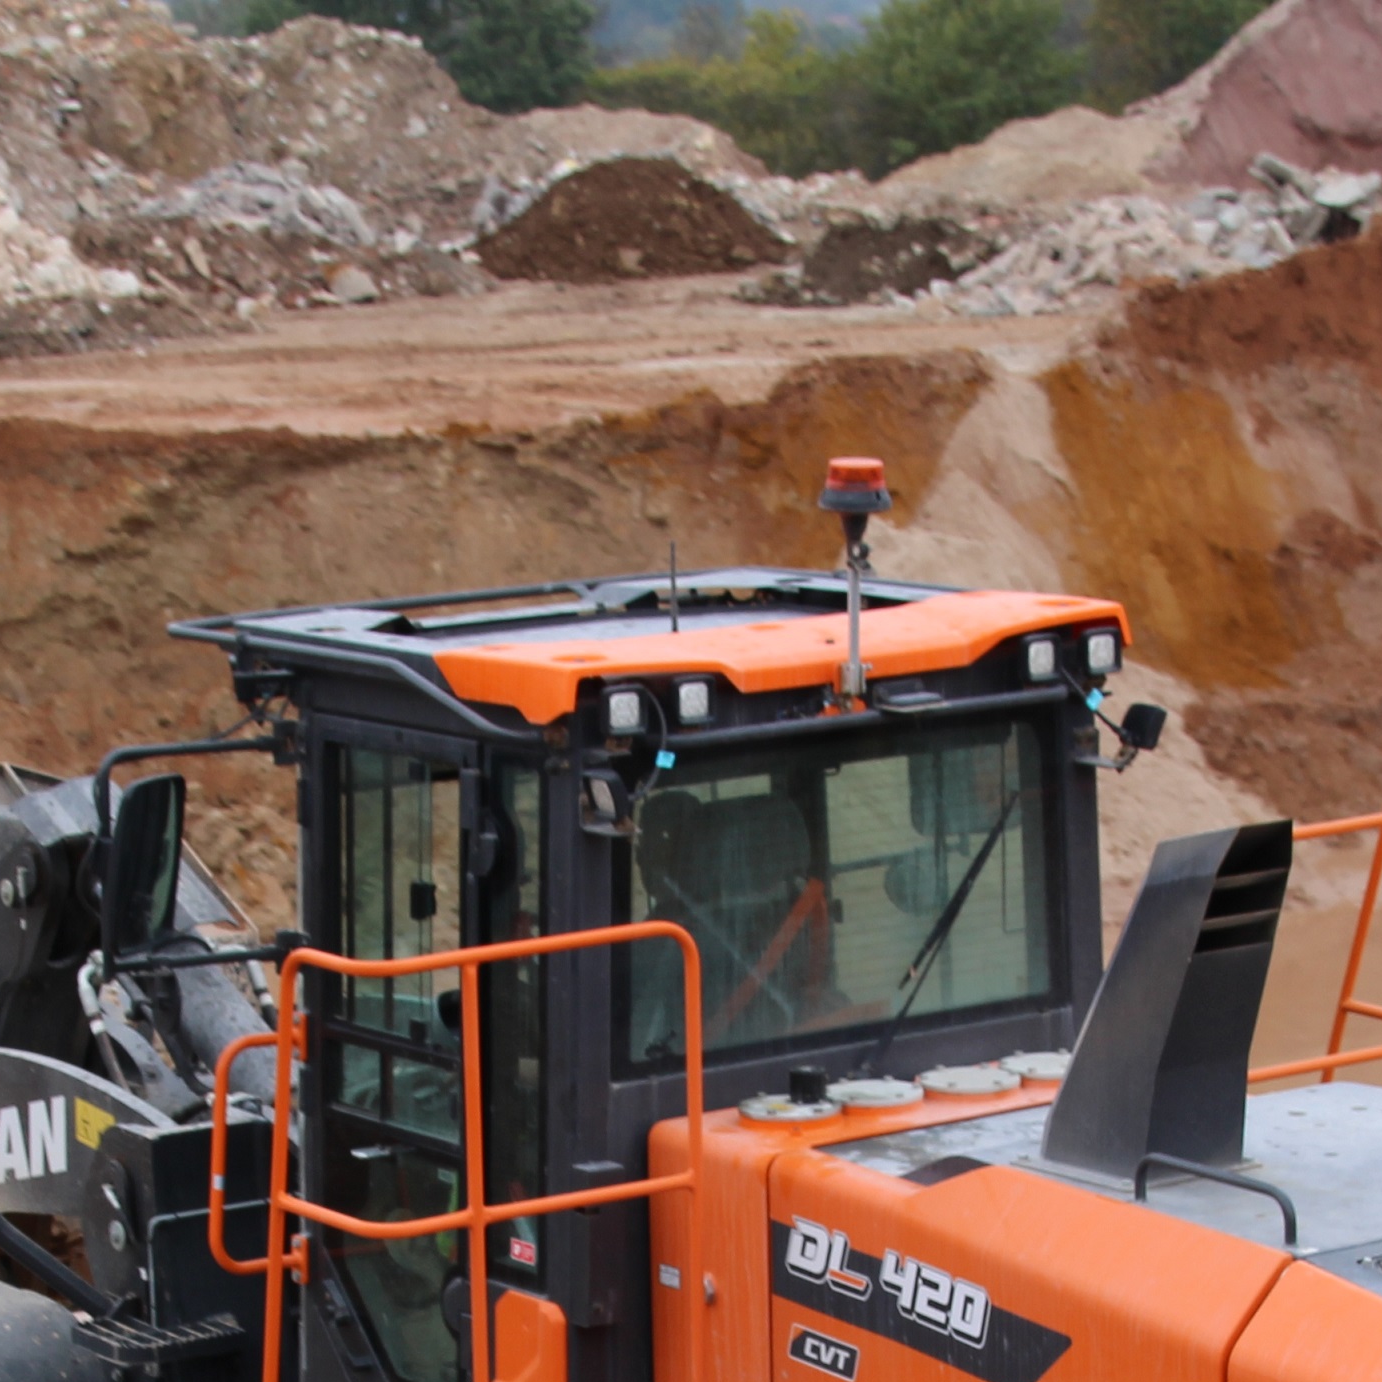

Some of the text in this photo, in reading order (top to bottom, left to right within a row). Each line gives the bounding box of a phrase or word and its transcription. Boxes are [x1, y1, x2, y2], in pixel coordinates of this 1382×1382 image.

[785, 1214, 991, 1350] DL 420
[803, 1336, 851, 1371] CVT
